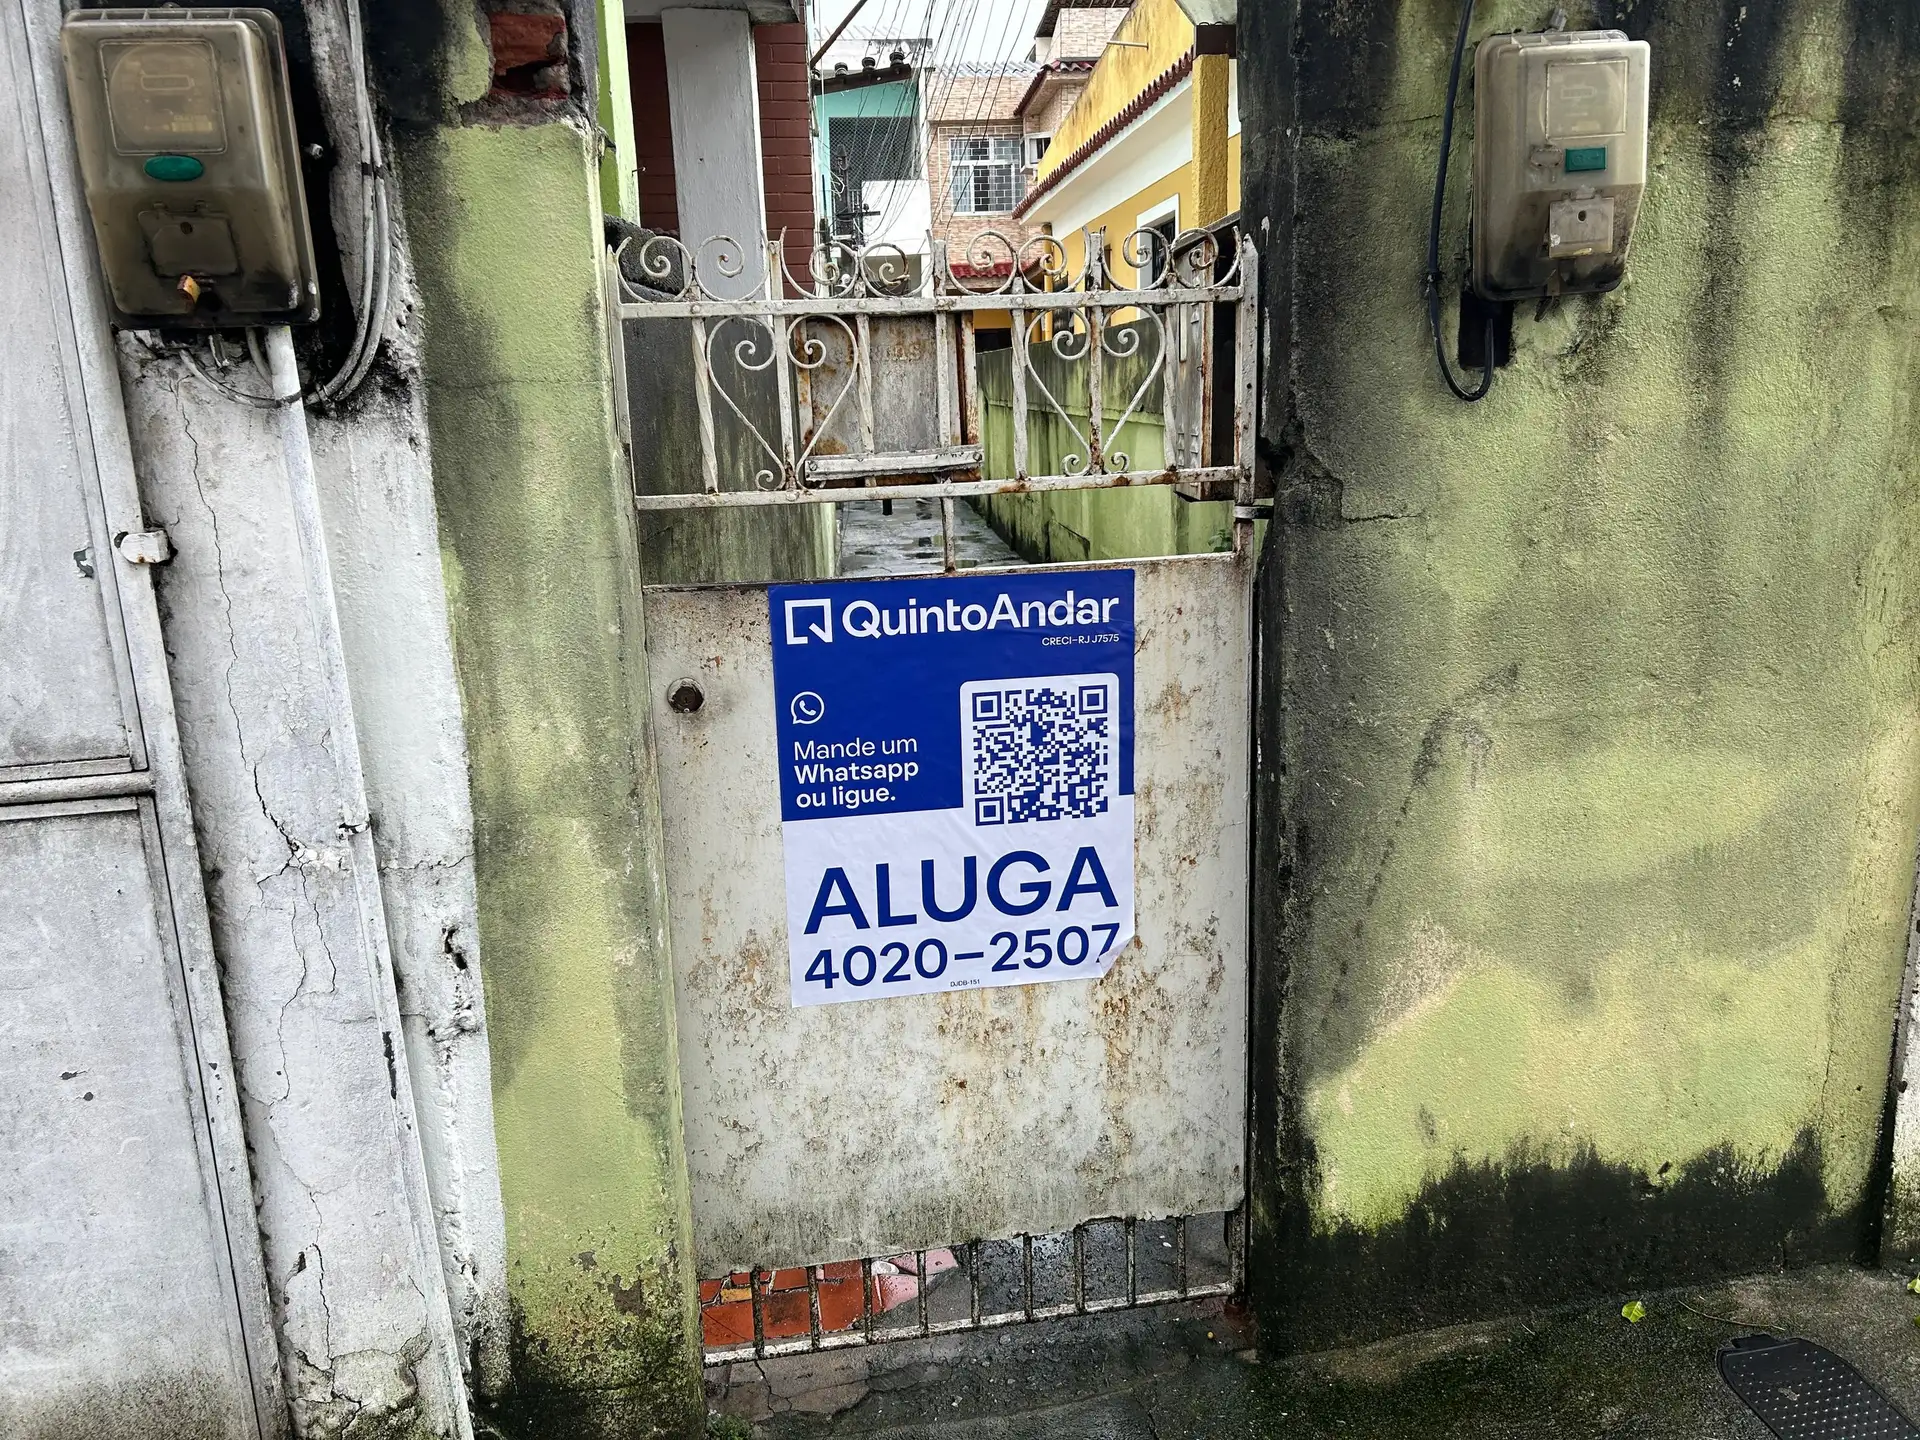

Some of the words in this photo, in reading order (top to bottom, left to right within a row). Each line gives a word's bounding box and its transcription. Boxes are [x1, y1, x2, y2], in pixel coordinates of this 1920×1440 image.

[842, 590, 1119, 639] QuintoAndar
[1041, 635, 1090, 646] CRECI-RJ
[1091, 633, 1120, 643] J7575
[793, 737, 876, 761] Mande
[882, 737, 918, 754] um
[794, 759, 919, 784] Whatsapp
[796, 791, 826, 808] ou
[832, 784, 896, 809] ligue.
[803, 846, 1119, 935] ALUGA
[804, 922, 1120, 989] 4020-2507
